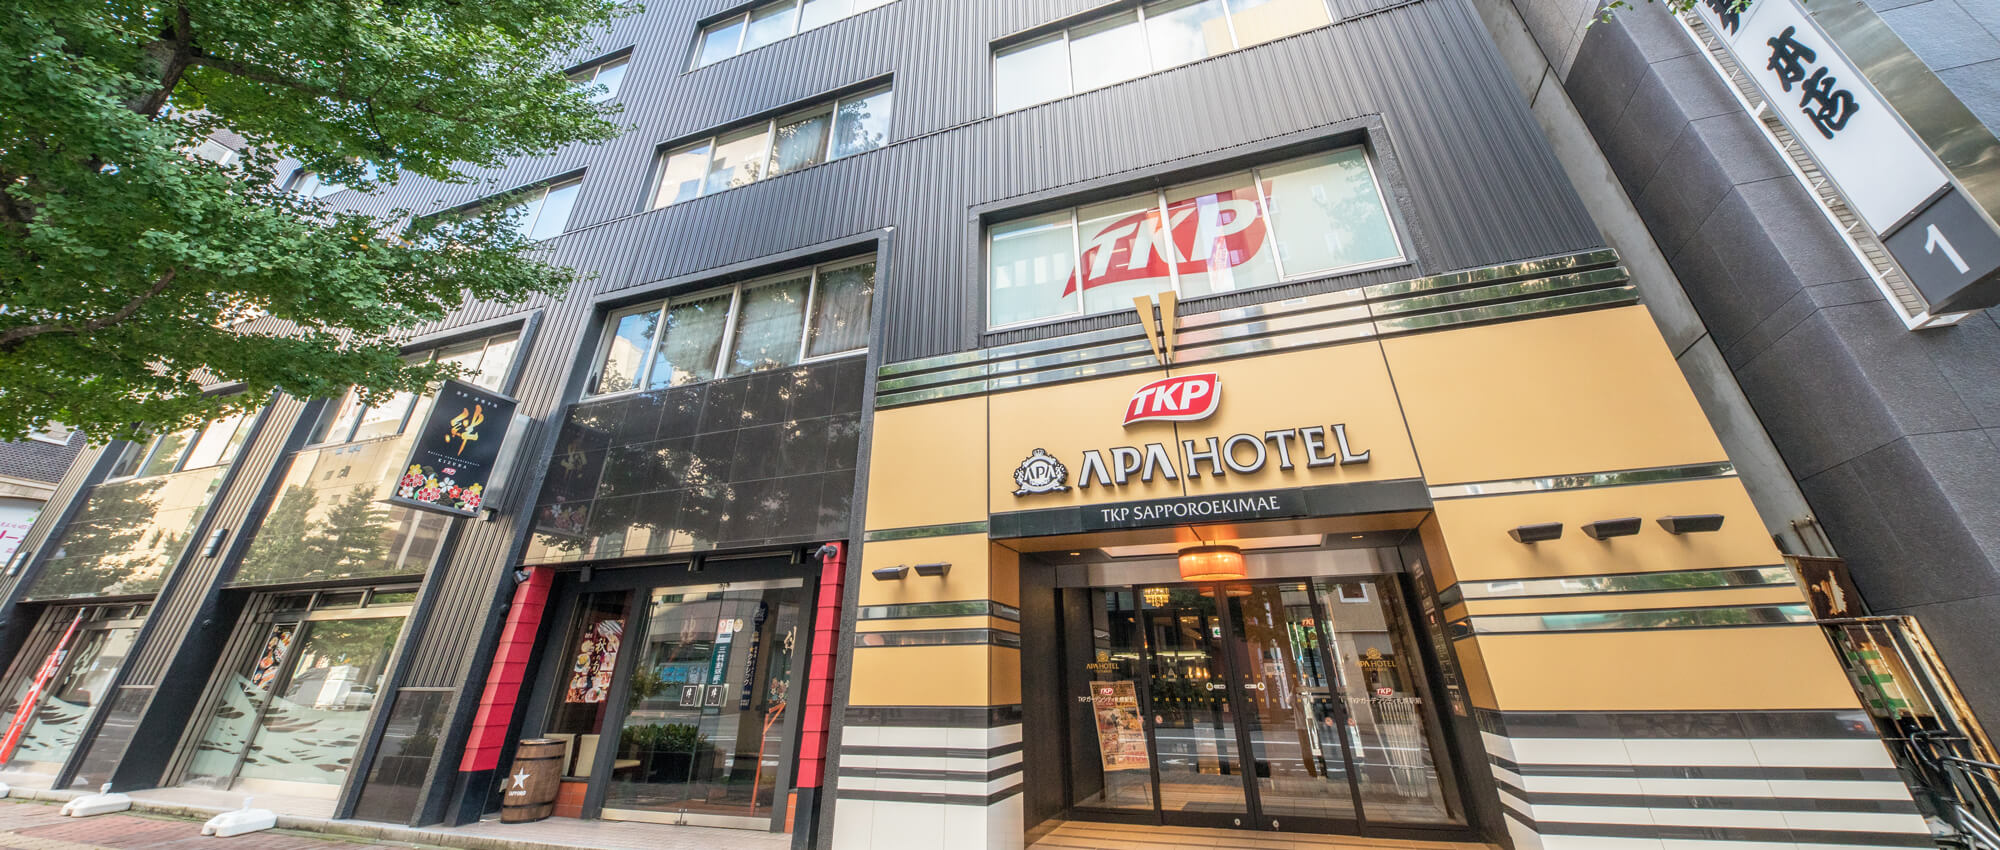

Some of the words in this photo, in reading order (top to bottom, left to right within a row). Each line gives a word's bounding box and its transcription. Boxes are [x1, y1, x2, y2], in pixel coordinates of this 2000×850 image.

[1088, 199, 1257, 281] TKP
[1924, 224, 1970, 274] 1
[1132, 380, 1210, 416] TKP
[445, 404, 484, 456] 絆
[1024, 465, 1057, 482] APA
[1078, 443, 1179, 488] APA
[1182, 424, 1370, 479] HOTEL
[1101, 508, 1130, 522] TKP
[1134, 496, 1281, 520] SAPPOROEKIMAE
[1377, 688, 1392, 696] TKP
